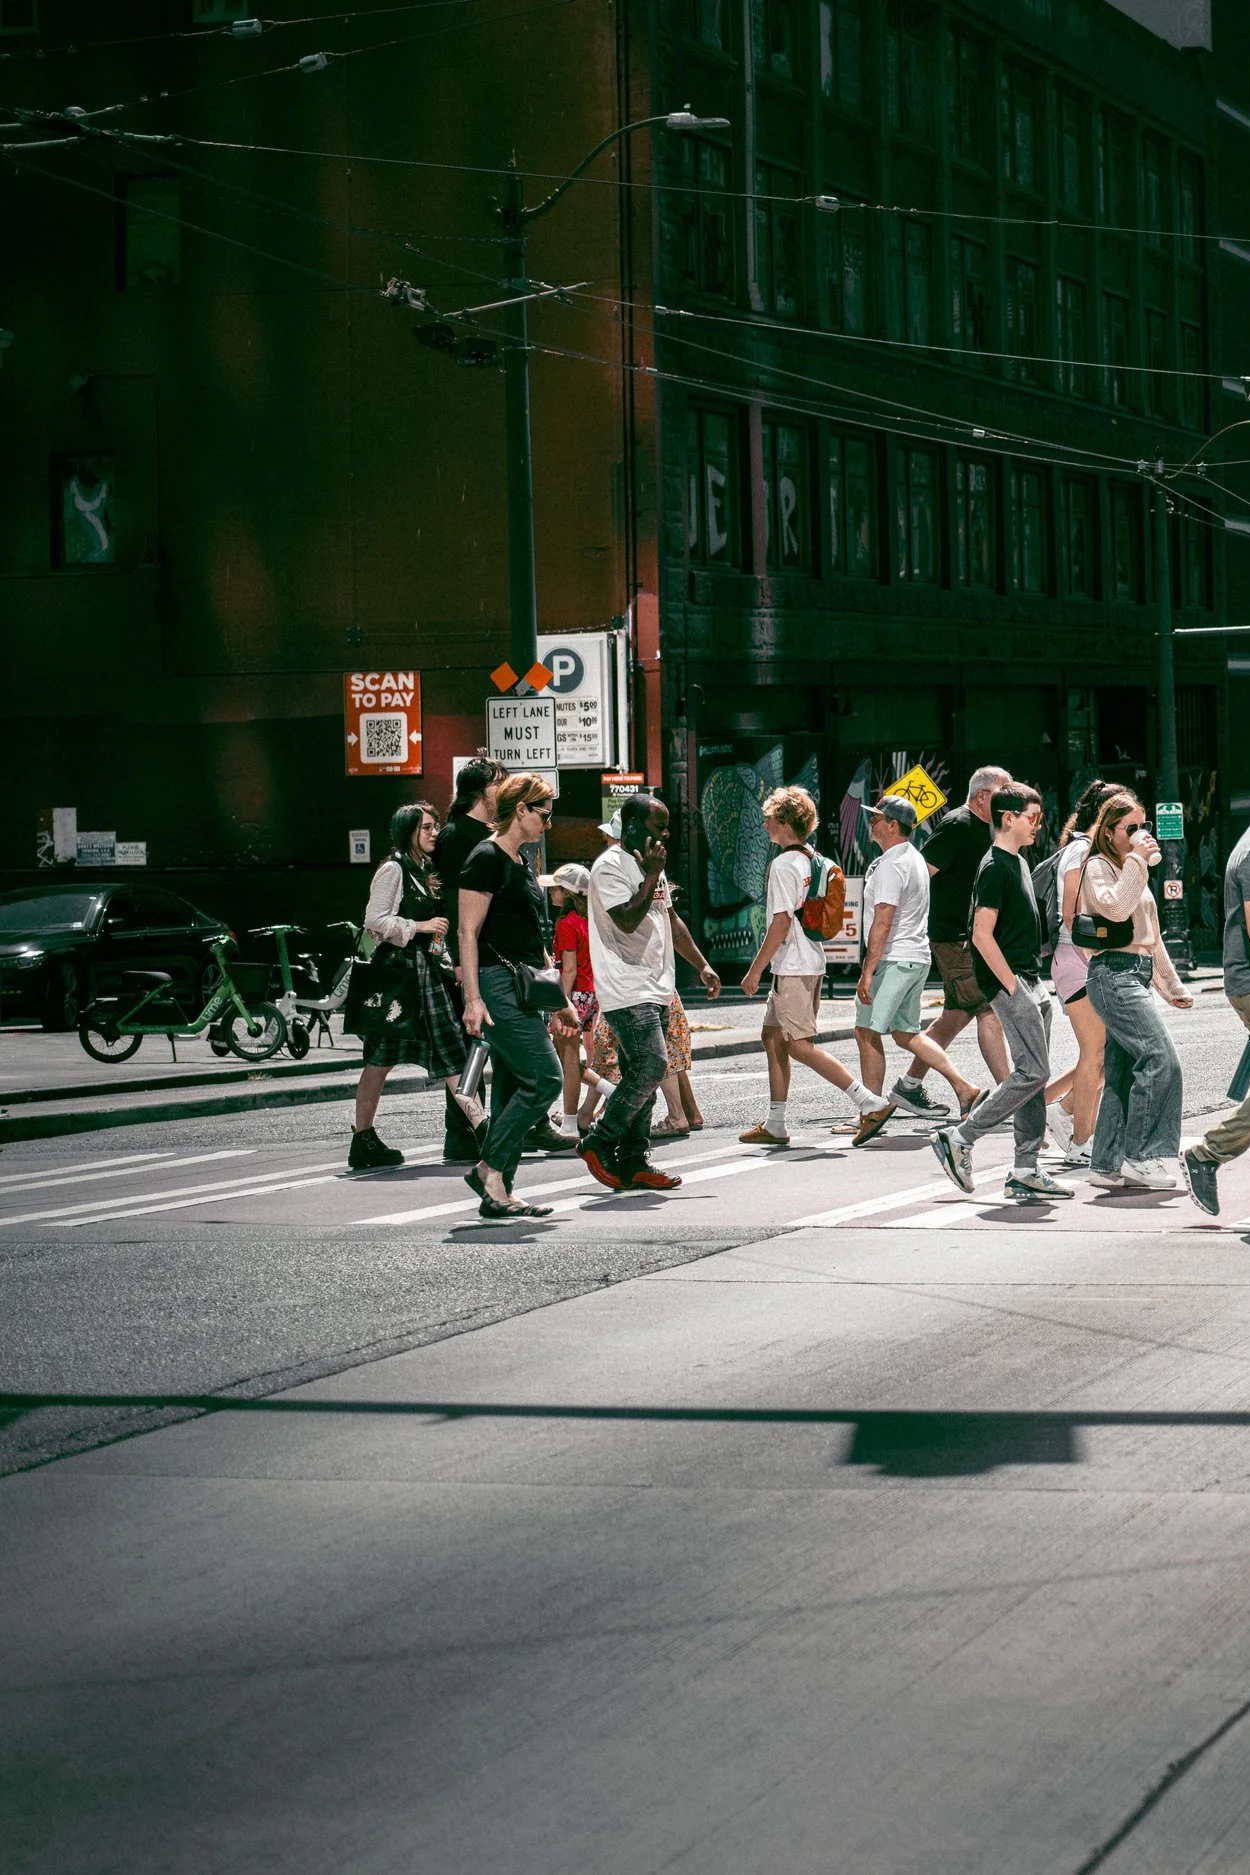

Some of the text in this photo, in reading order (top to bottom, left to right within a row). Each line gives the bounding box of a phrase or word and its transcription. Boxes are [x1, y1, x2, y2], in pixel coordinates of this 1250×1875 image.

[553, 655, 575, 686] P
[351, 672, 414, 691] SCAN
[351, 692, 415, 708] TO PAY
[556, 702, 577, 711] NUTES
[493, 706, 550, 718] LEFT LANE
[504, 726, 539, 740] MUST
[494, 749, 521, 760] TURN
[527, 748, 551, 759] LEFT
[610, 785, 639, 793] 770431
[841, 924, 857, 937] 5
[334, 975, 350, 997] Lime
[201, 996, 223, 1020] Lime
